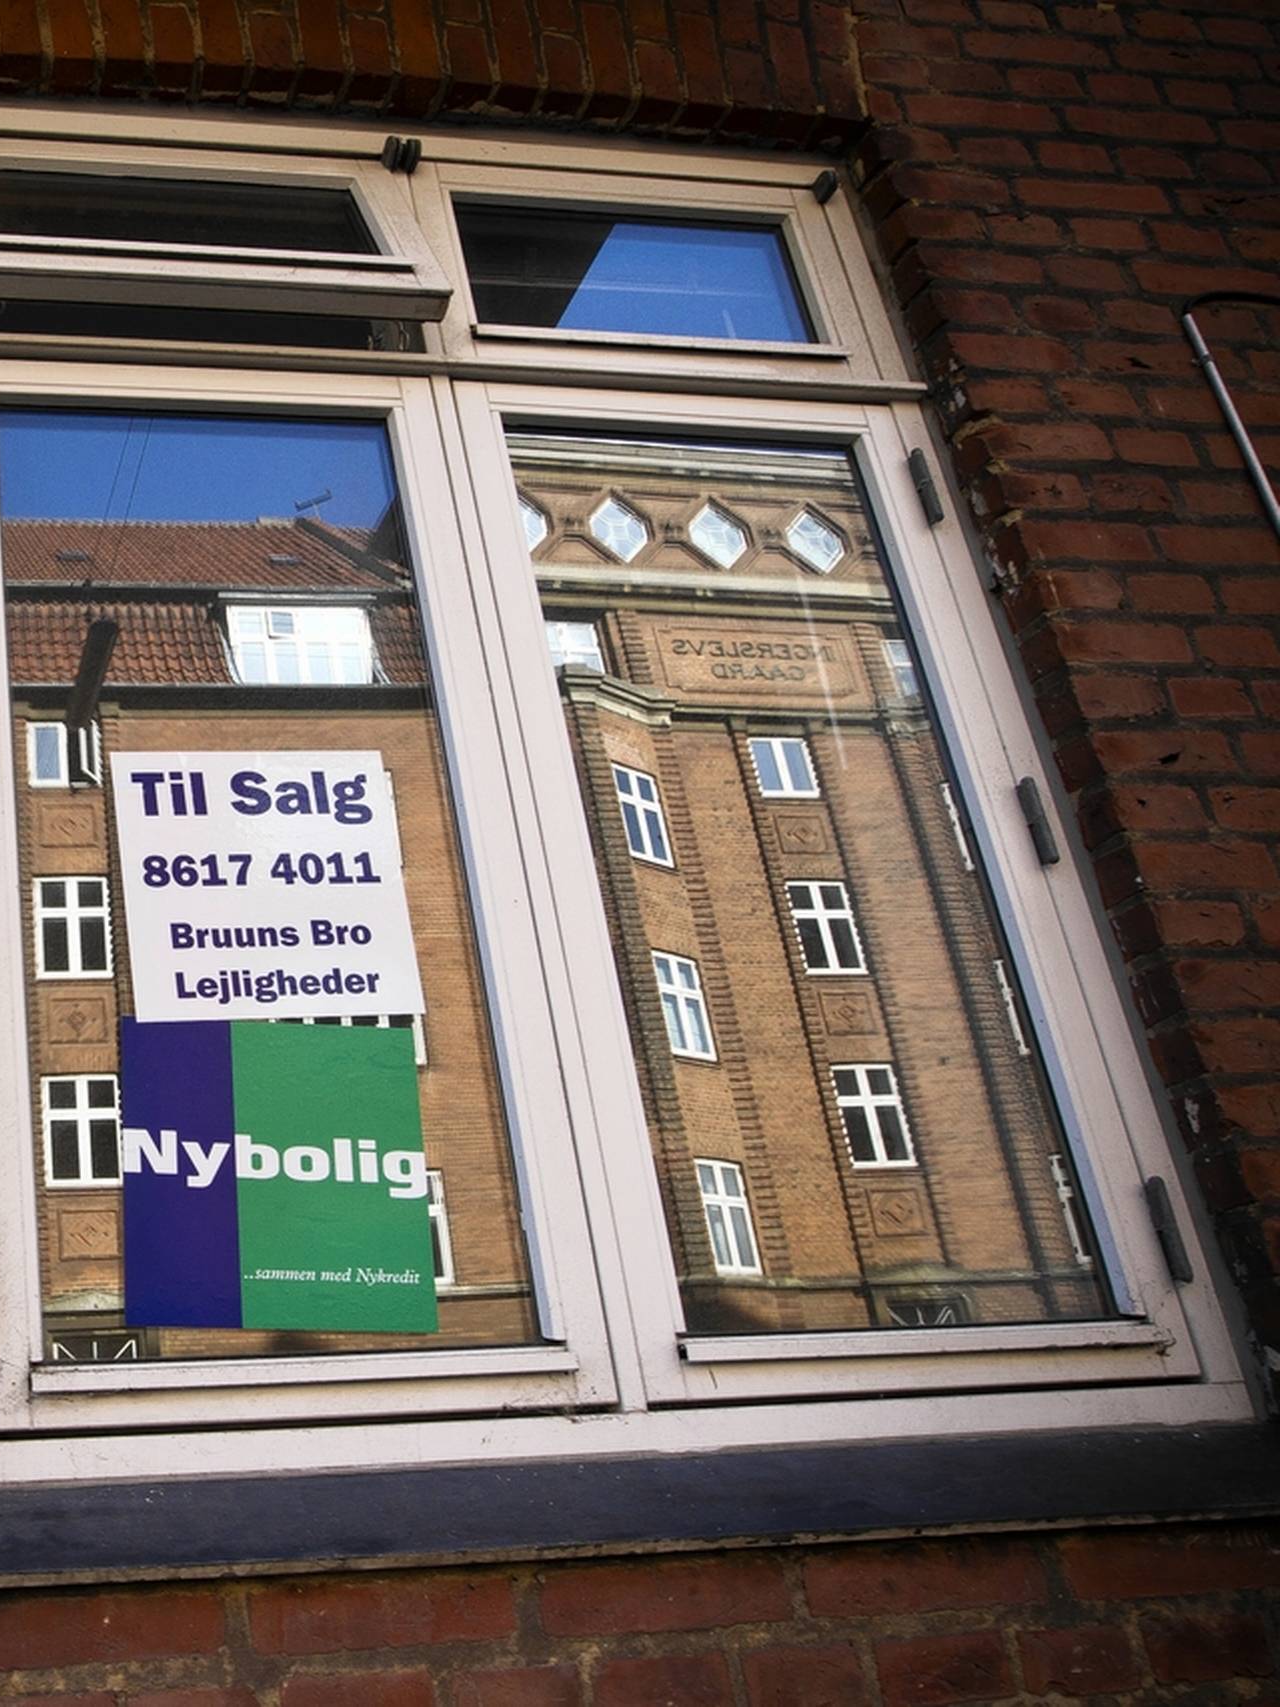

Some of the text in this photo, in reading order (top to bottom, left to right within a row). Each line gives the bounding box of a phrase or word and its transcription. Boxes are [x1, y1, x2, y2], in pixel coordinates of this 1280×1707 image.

[130, 771, 373, 825] Til Salg
[142, 852, 382, 888] 8617 4011
[170, 919, 372, 950] Bruuns Bro
[175, 968, 380, 1004] Lejligheder
[122, 1128, 429, 1199] Nybolig
[320, 1267, 352, 1283] med
[356, 1268, 421, 1287] Nykredit
